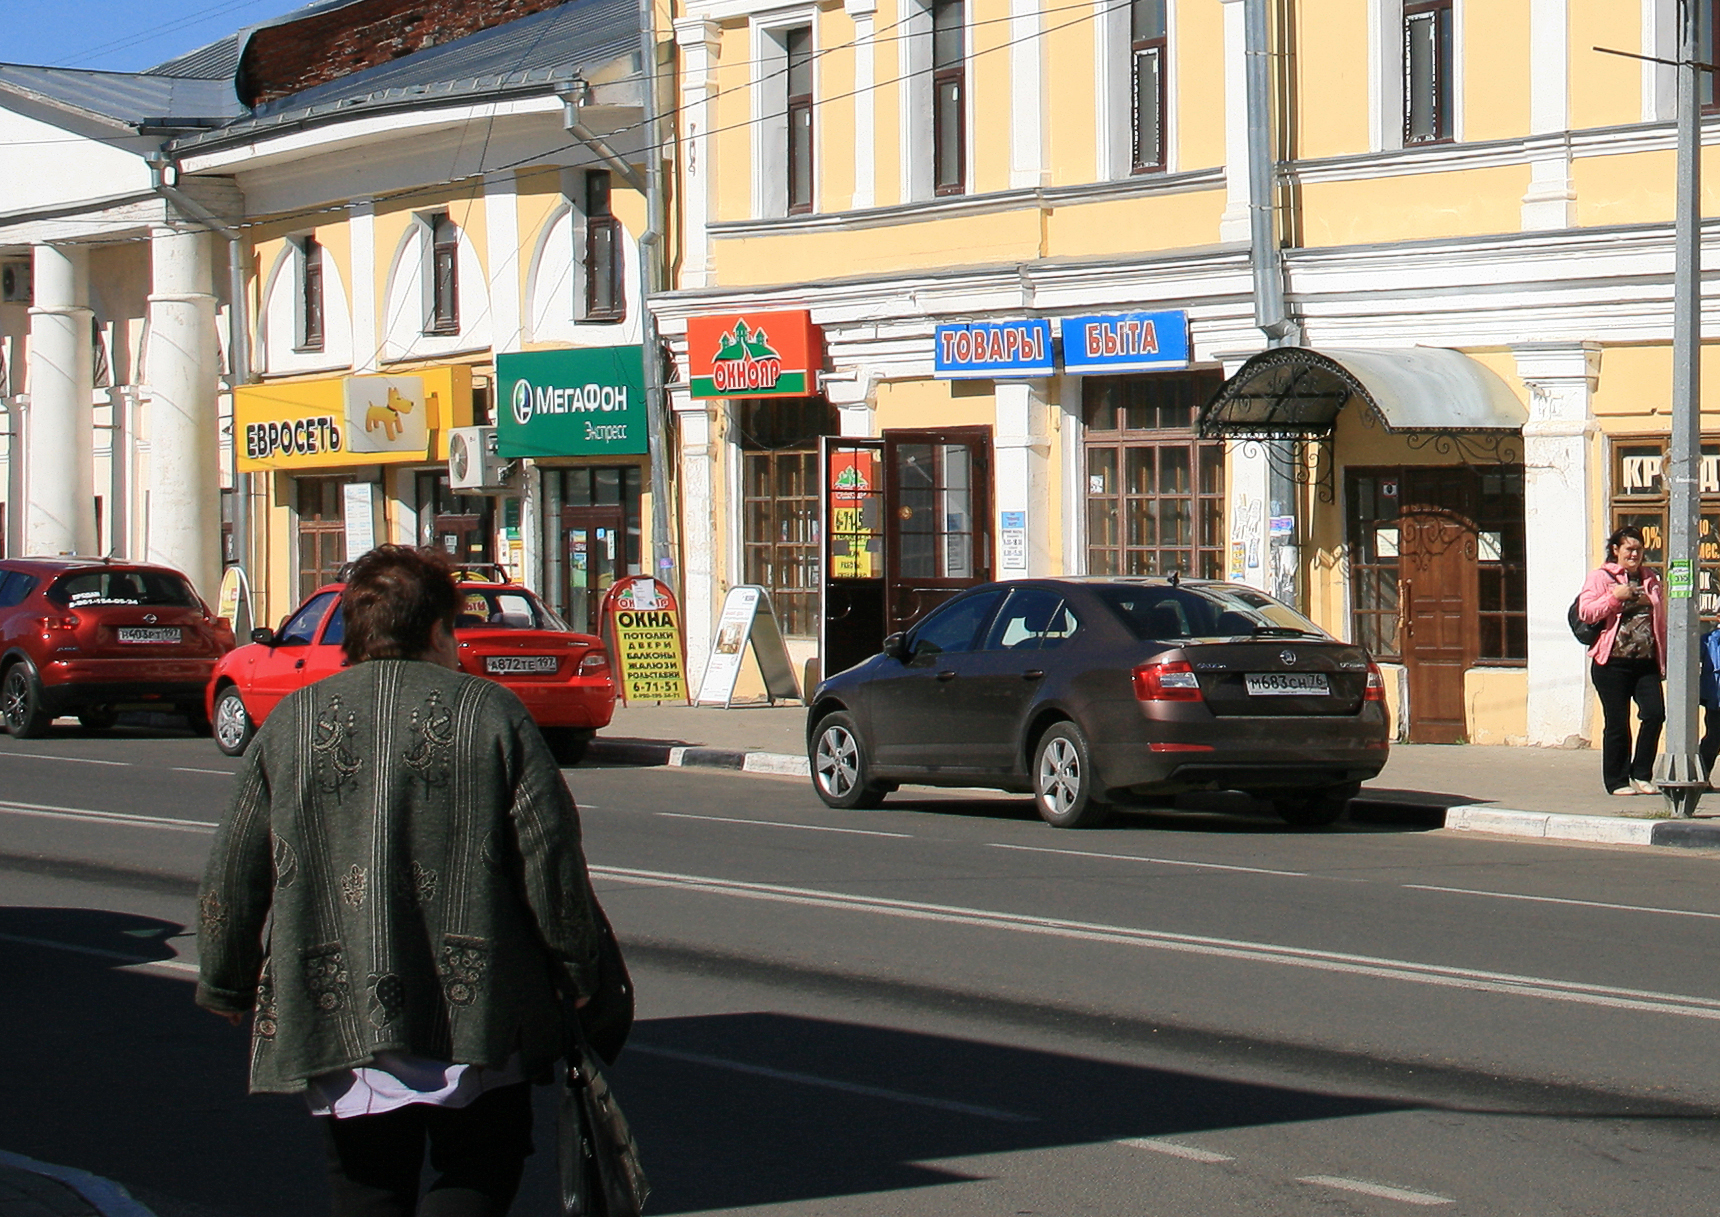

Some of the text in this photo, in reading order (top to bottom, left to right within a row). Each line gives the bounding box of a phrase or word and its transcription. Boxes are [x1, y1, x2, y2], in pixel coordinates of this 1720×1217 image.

[941, 327, 1044, 364] ТОВАРЫ
[1085, 320, 1158, 358] БЫТА
[714, 359, 780, 391] ОКНОЯР
[246, 415, 341, 459] ЕВРОСЕТЬ
[584, 420, 627, 443] Экспресс
[618, 612, 676, 628] ОКНА
[623, 632, 673, 640] ПОТОЛКИ
[628, 642, 671, 650] ДВЕРИ
[627, 651, 676, 660] БАЛКОНЫ
[491, 657, 555, 671] А872ТЕ 197
[629, 662, 677, 670] ЖАЛЮЗИ
[633, 681, 678, 692] 6-71-51
[1250, 674, 1323, 689] М683СН 76
